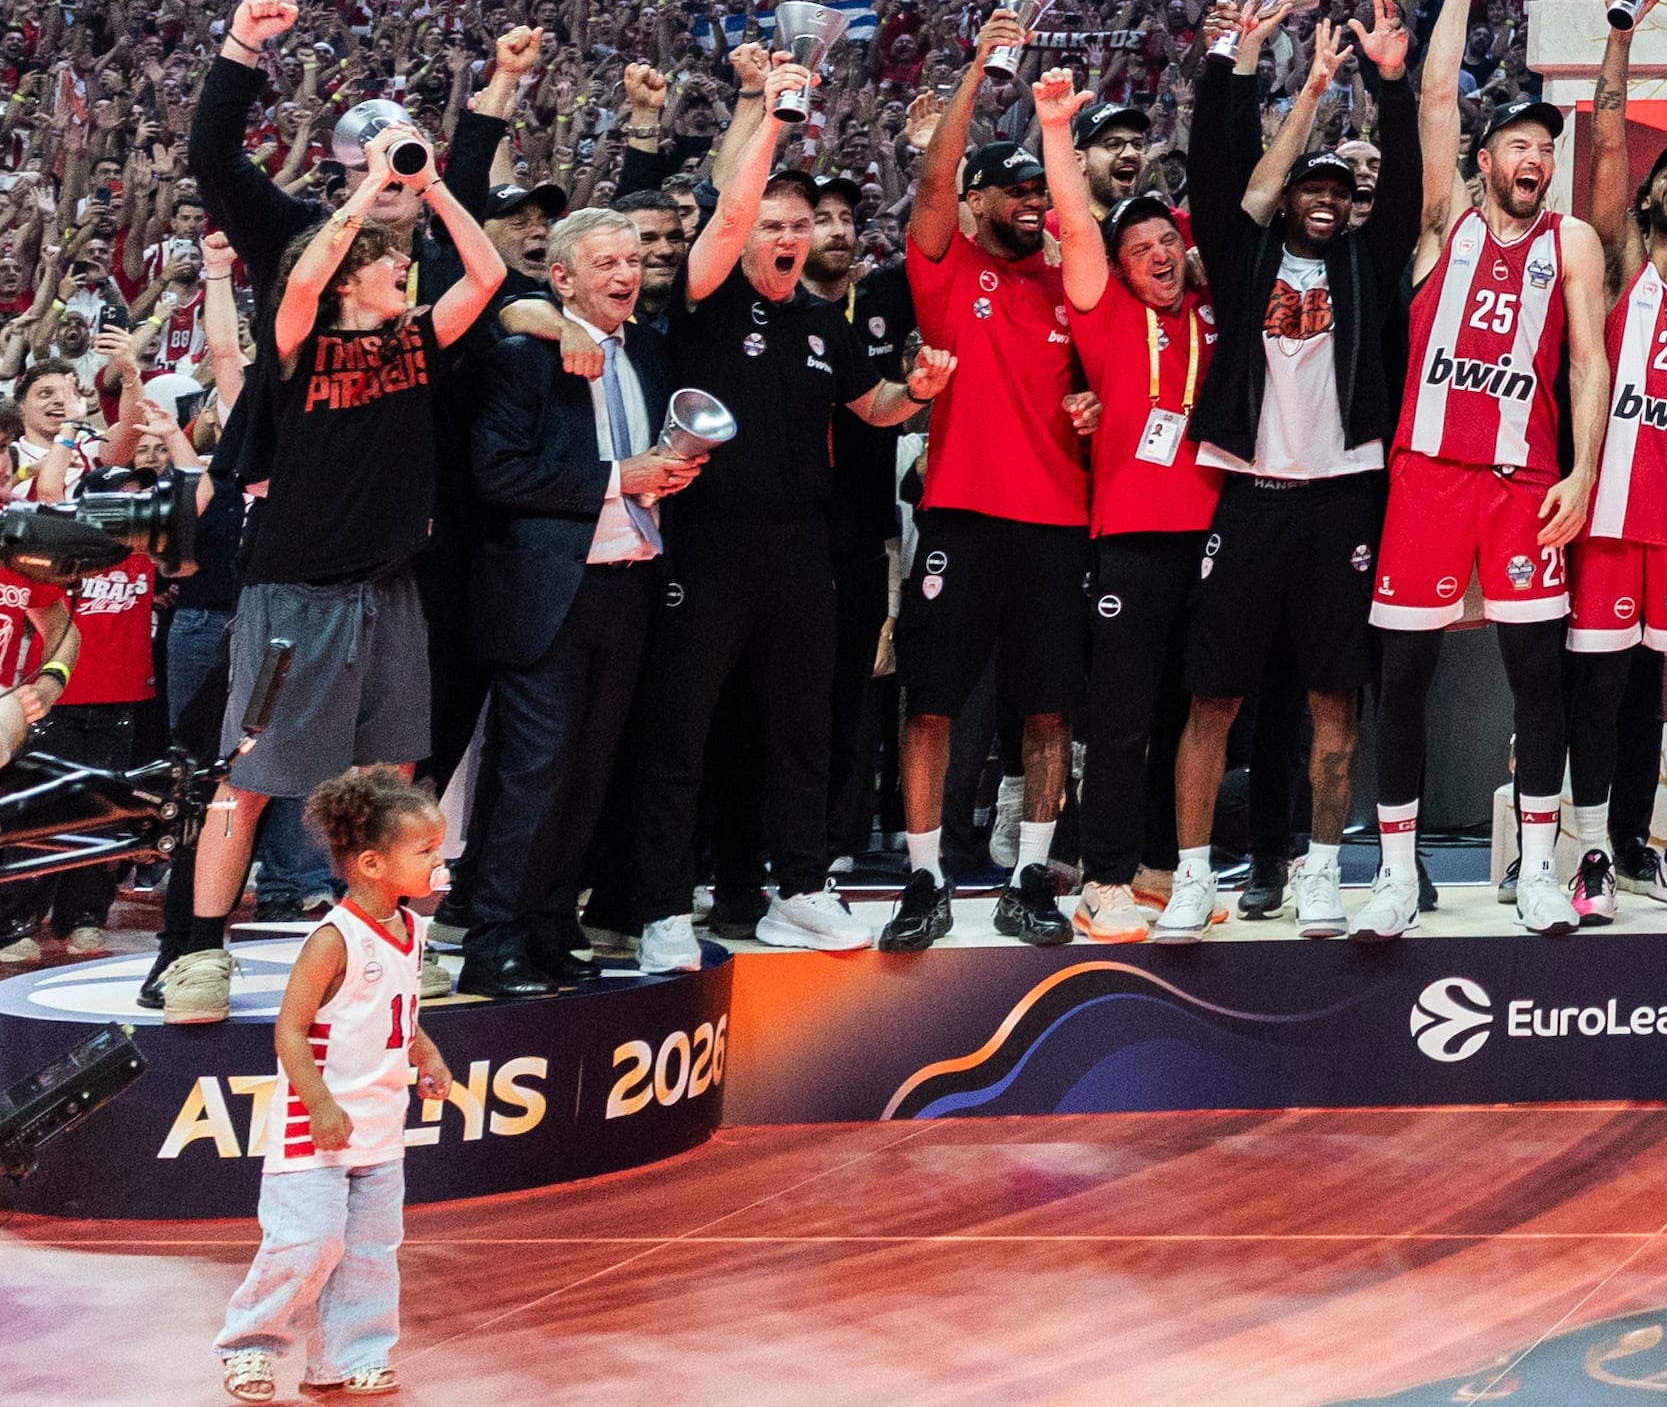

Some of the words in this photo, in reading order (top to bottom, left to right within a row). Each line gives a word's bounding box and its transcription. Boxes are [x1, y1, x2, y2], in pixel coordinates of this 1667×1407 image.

[1468, 288, 1520, 336] 25
[171, 330, 190, 348] 88
[867, 342, 894, 357] bwin
[1047, 329, 1072, 345] bwi
[315, 334, 384, 371] THIS
[1425, 346, 1537, 403] bwin
[1400, 819, 1417, 832] GS
[157, 1056, 548, 1158] ATENS
[605, 1013, 727, 1120] 2026
